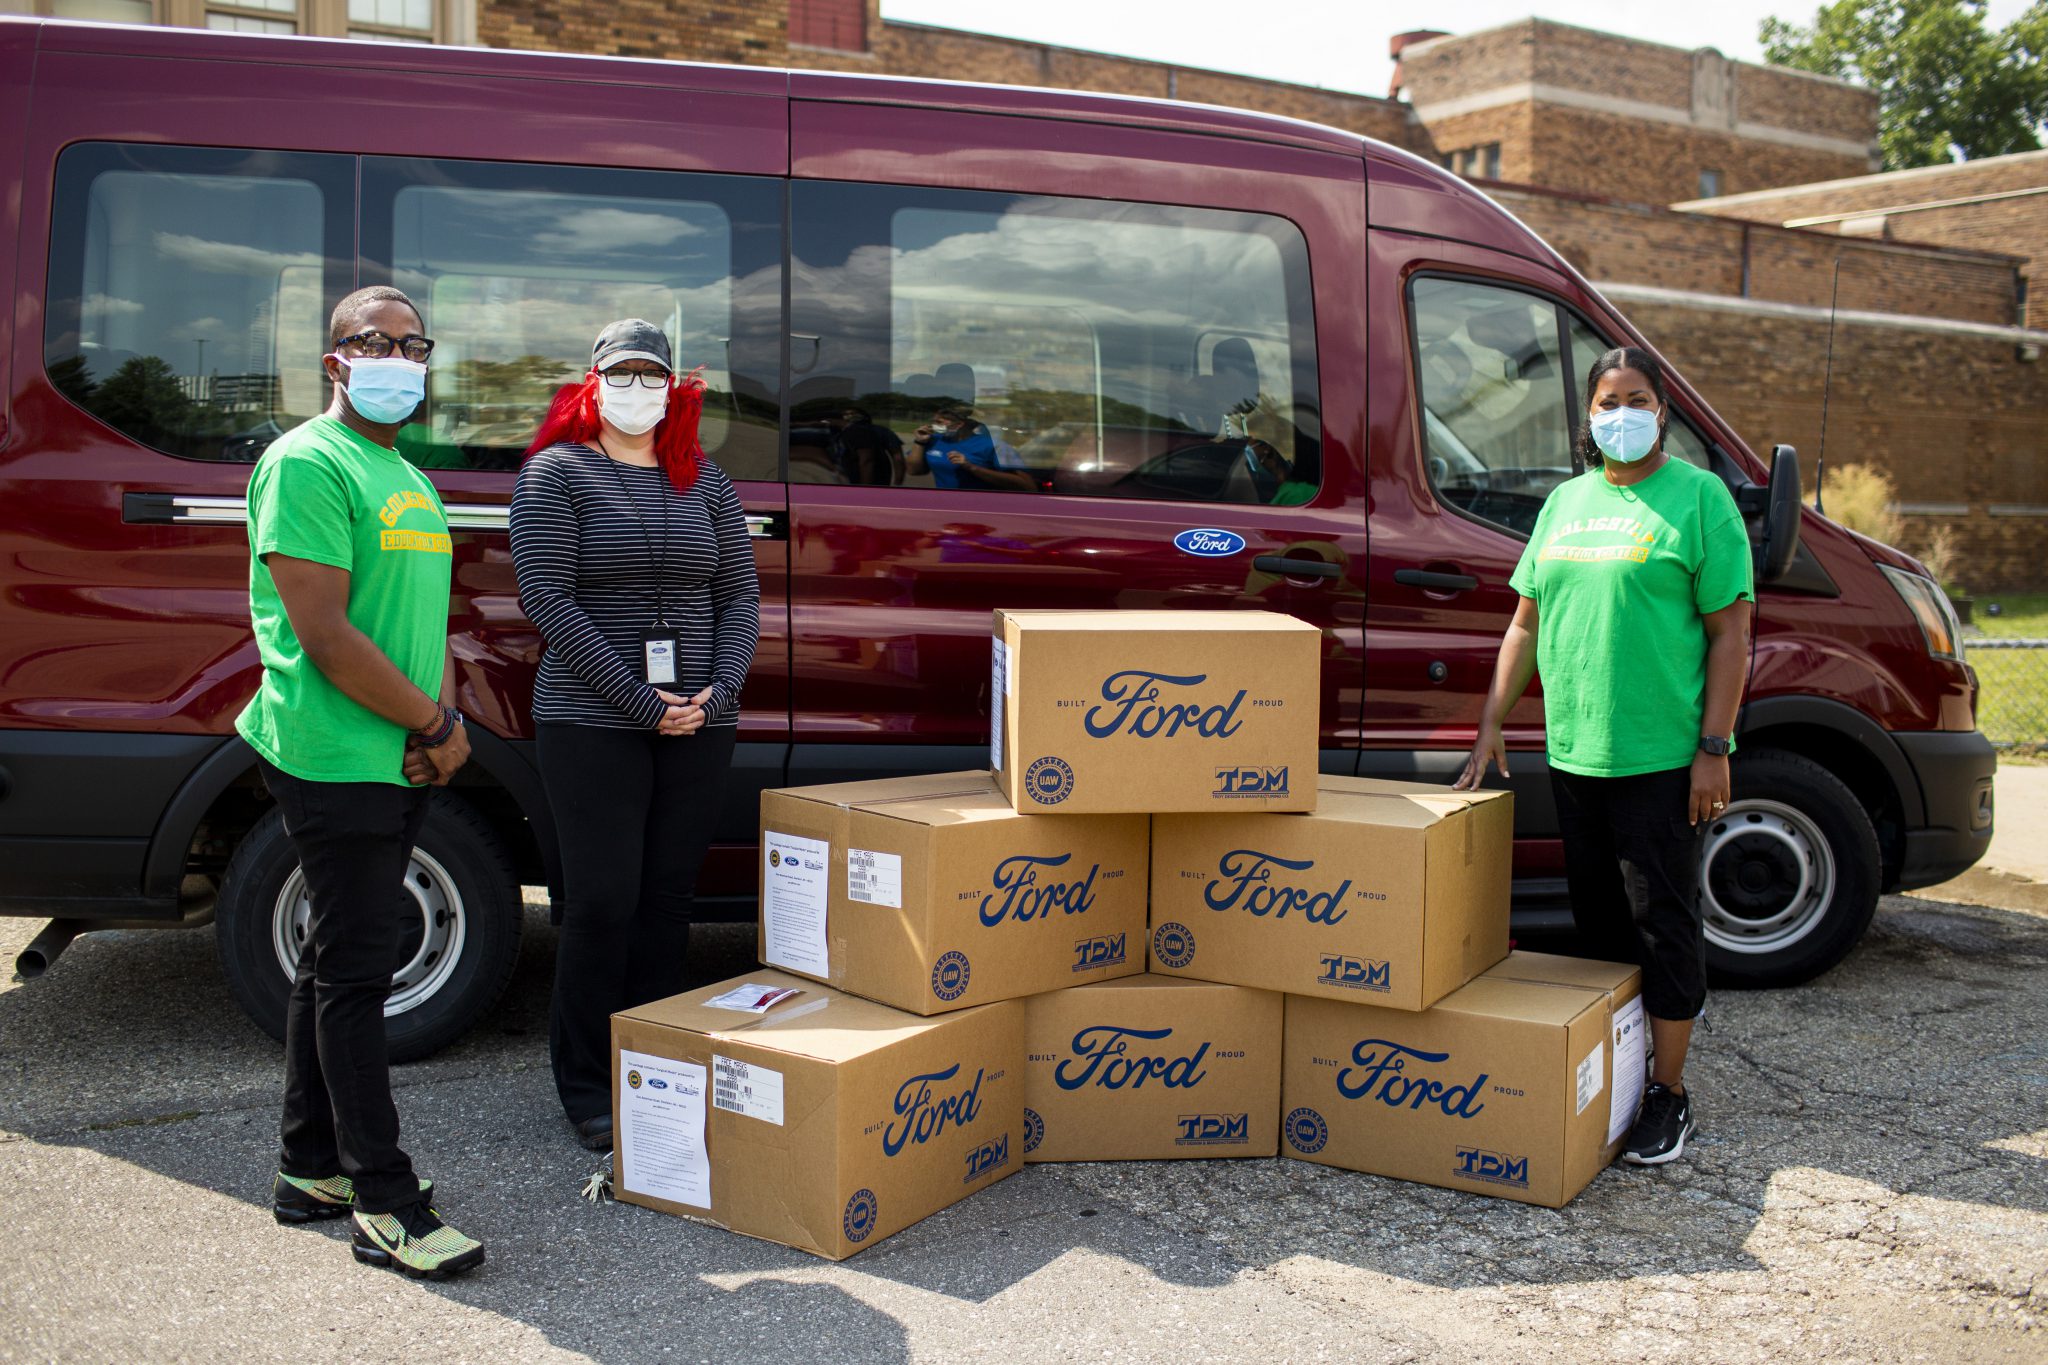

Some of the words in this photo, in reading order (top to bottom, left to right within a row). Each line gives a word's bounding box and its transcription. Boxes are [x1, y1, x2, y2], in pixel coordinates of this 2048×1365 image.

[379, 490, 437, 528] GOLIGHT
[1188, 531, 1231, 551] Ford
[1084, 670, 1248, 739] Ford
[1039, 775, 1059, 786] UAW
[1215, 766, 1289, 792] TDM
[958, 890, 981, 901] BUILT
[978, 852, 1100, 927] Ford
[1102, 869, 1124, 879] PROUD
[1181, 870, 1206, 880] BUILT
[1203, 849, 1353, 926] Ford
[1357, 891, 1387, 901] PROUD
[1075, 933, 1126, 965] TDM
[1165, 939, 1183, 951] UAW
[943, 970, 959, 982] UAW
[1320, 953, 1389, 987] TDM
[1028, 1054, 1057, 1062] BUILT
[1054, 1025, 1212, 1091] Ford
[1215, 1050, 1245, 1058] PROUD
[1312, 1057, 1338, 1067] BUILT
[1336, 1038, 1489, 1119] Ford
[1493, 1086, 1525, 1097] PROUD
[864, 1120, 884, 1136] BUILT
[882, 1062, 984, 1157] Ford
[986, 1069, 1005, 1083] PROUD
[1178, 1113, 1249, 1139] TDM
[1297, 1125, 1315, 1137] UAW
[966, 1132, 1009, 1175] TDM
[1456, 1145, 1528, 1182] TDM
